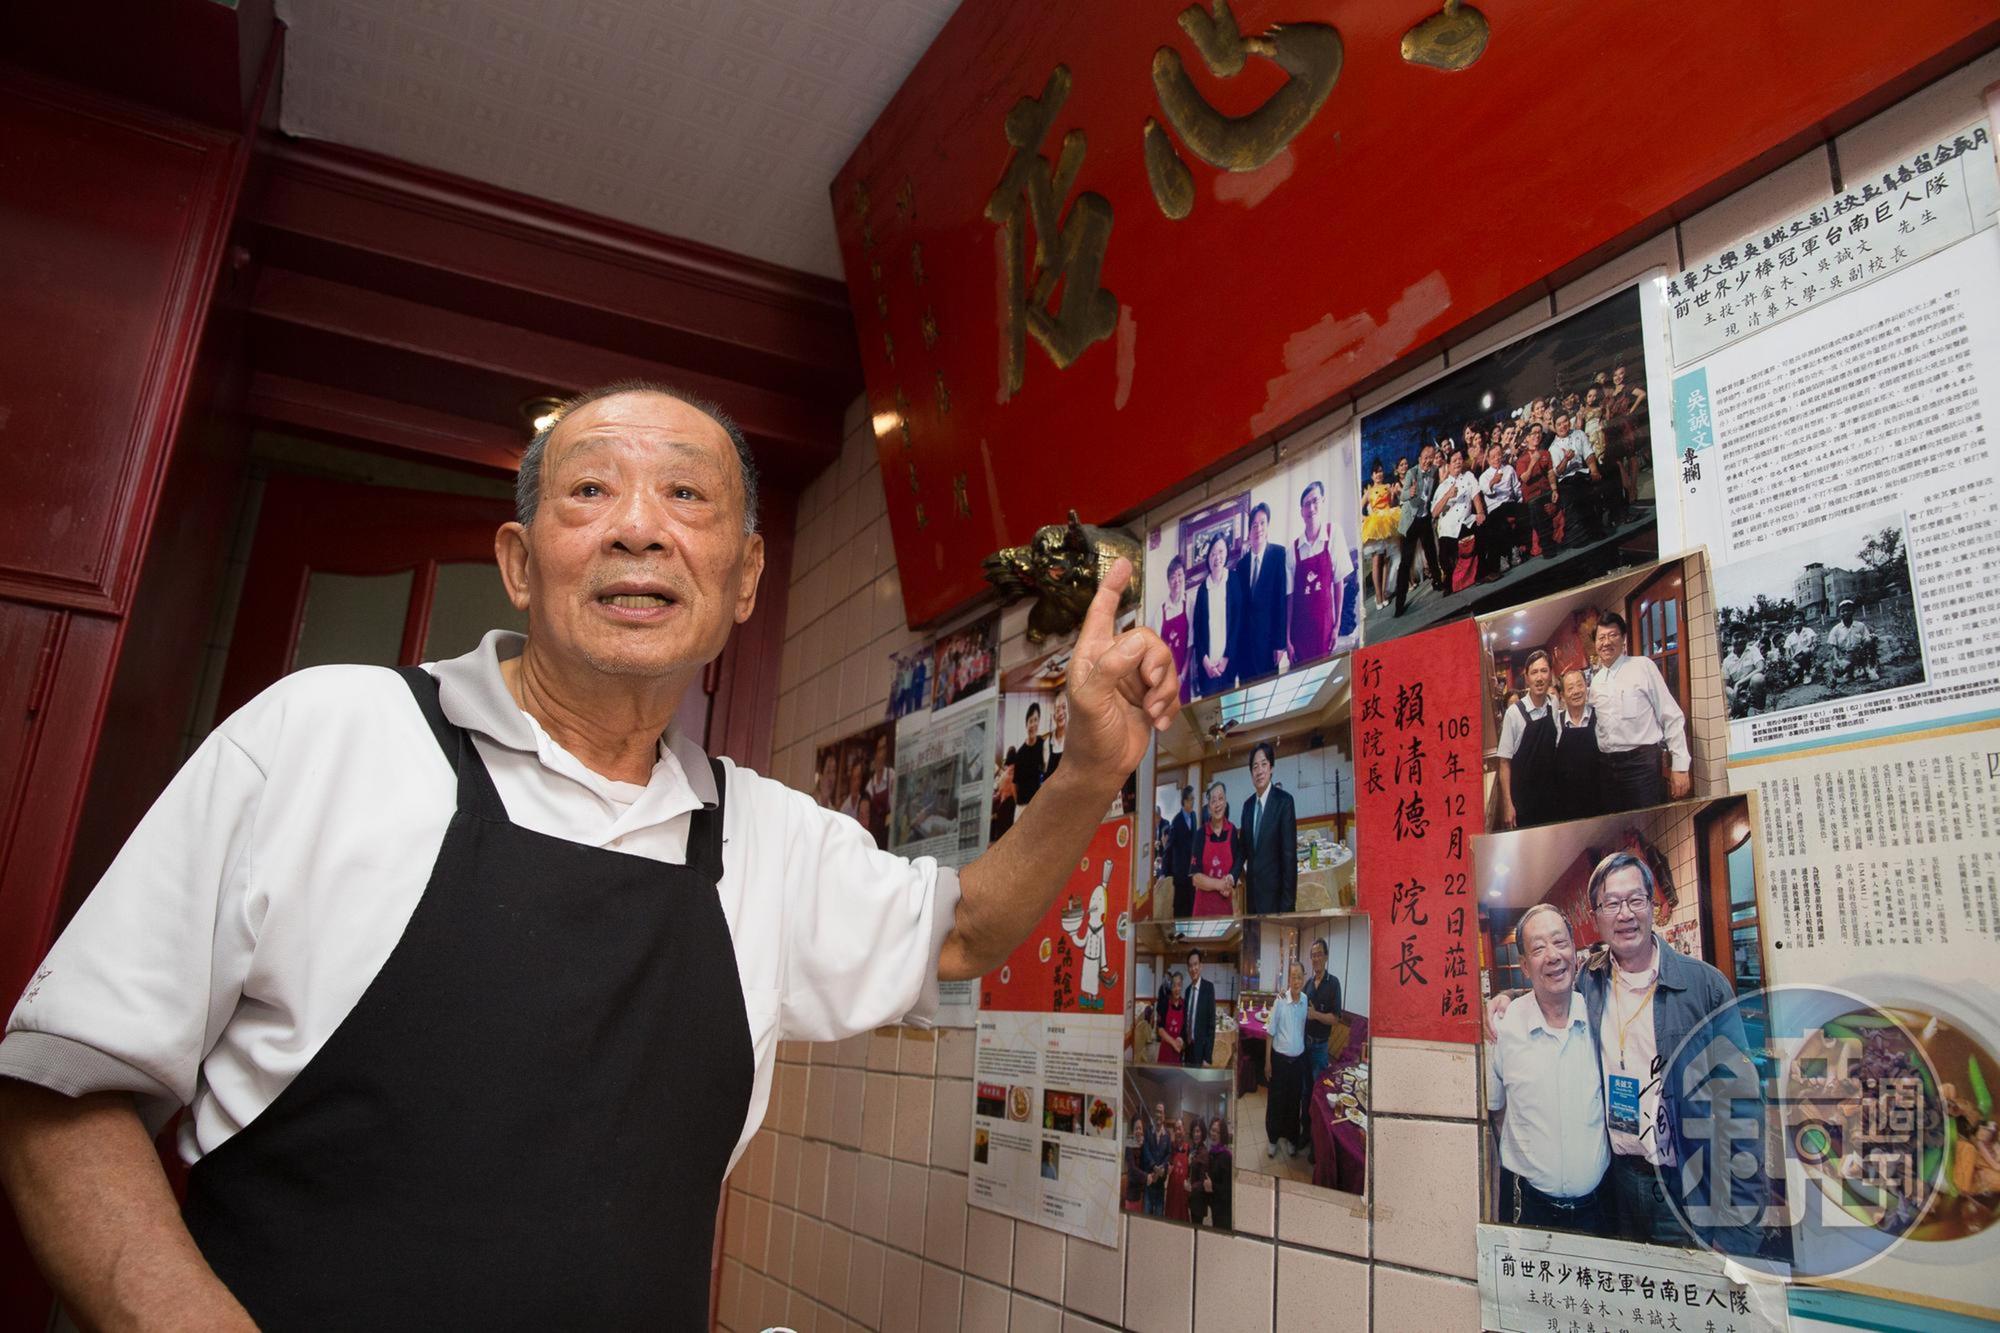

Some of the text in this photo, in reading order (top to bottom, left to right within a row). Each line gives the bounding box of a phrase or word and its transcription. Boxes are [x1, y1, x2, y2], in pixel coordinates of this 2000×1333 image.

[1674, 172, 1949, 319] 前世界少棒冠軍台南巨人隊
[1898, 209, 1938, 235] 先生
[1687, 388, 1713, 452] 吳誠文
[1361, 658, 1386, 795] 行政院長
[1390, 682, 1431, 987] 賴清德 院長
[1501, 1254, 1752, 1315] 前世界少棒冠軍台南巨人隊
